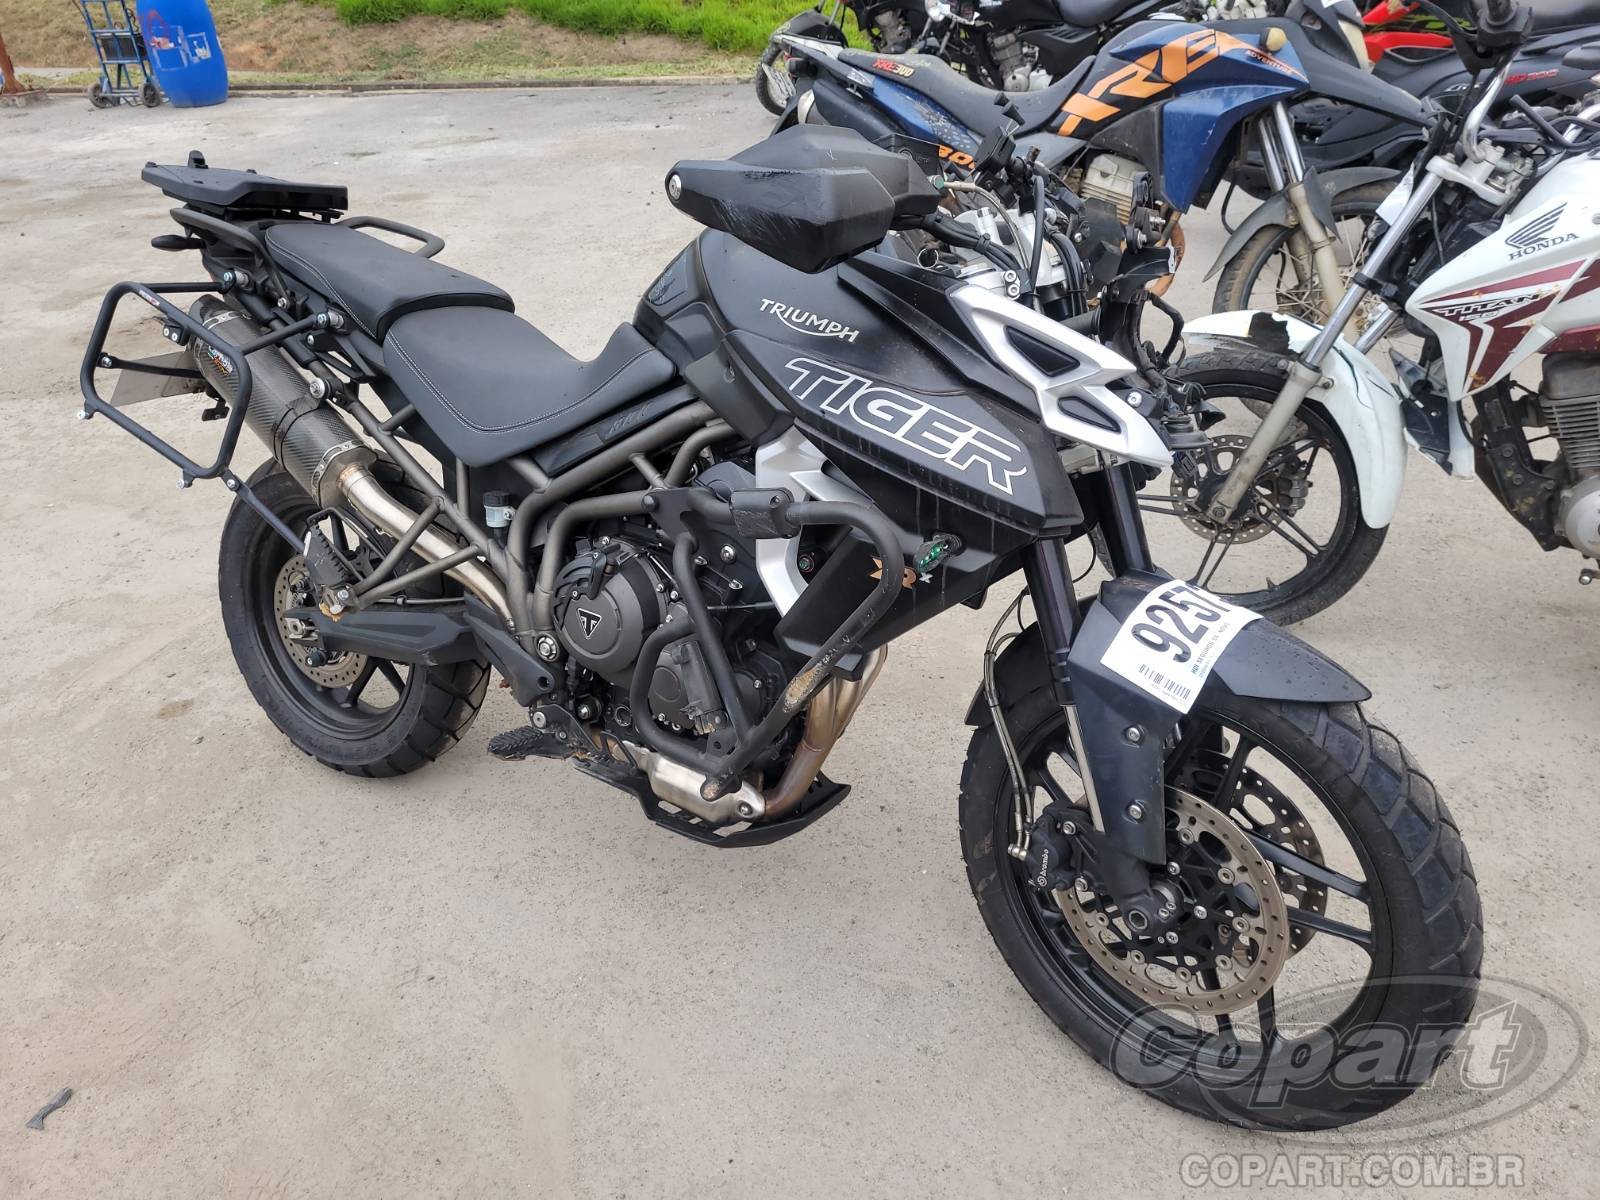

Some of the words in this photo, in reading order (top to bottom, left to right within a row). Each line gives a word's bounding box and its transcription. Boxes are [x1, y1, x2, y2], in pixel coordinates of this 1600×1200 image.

[1508, 233, 1579, 261] HONDA
[1431, 294, 1542, 317] TITAN
[759, 298, 859, 343] TRIUMPH
[785, 357, 1027, 495] TIGER
[1040, 848, 1049, 876] brembo
